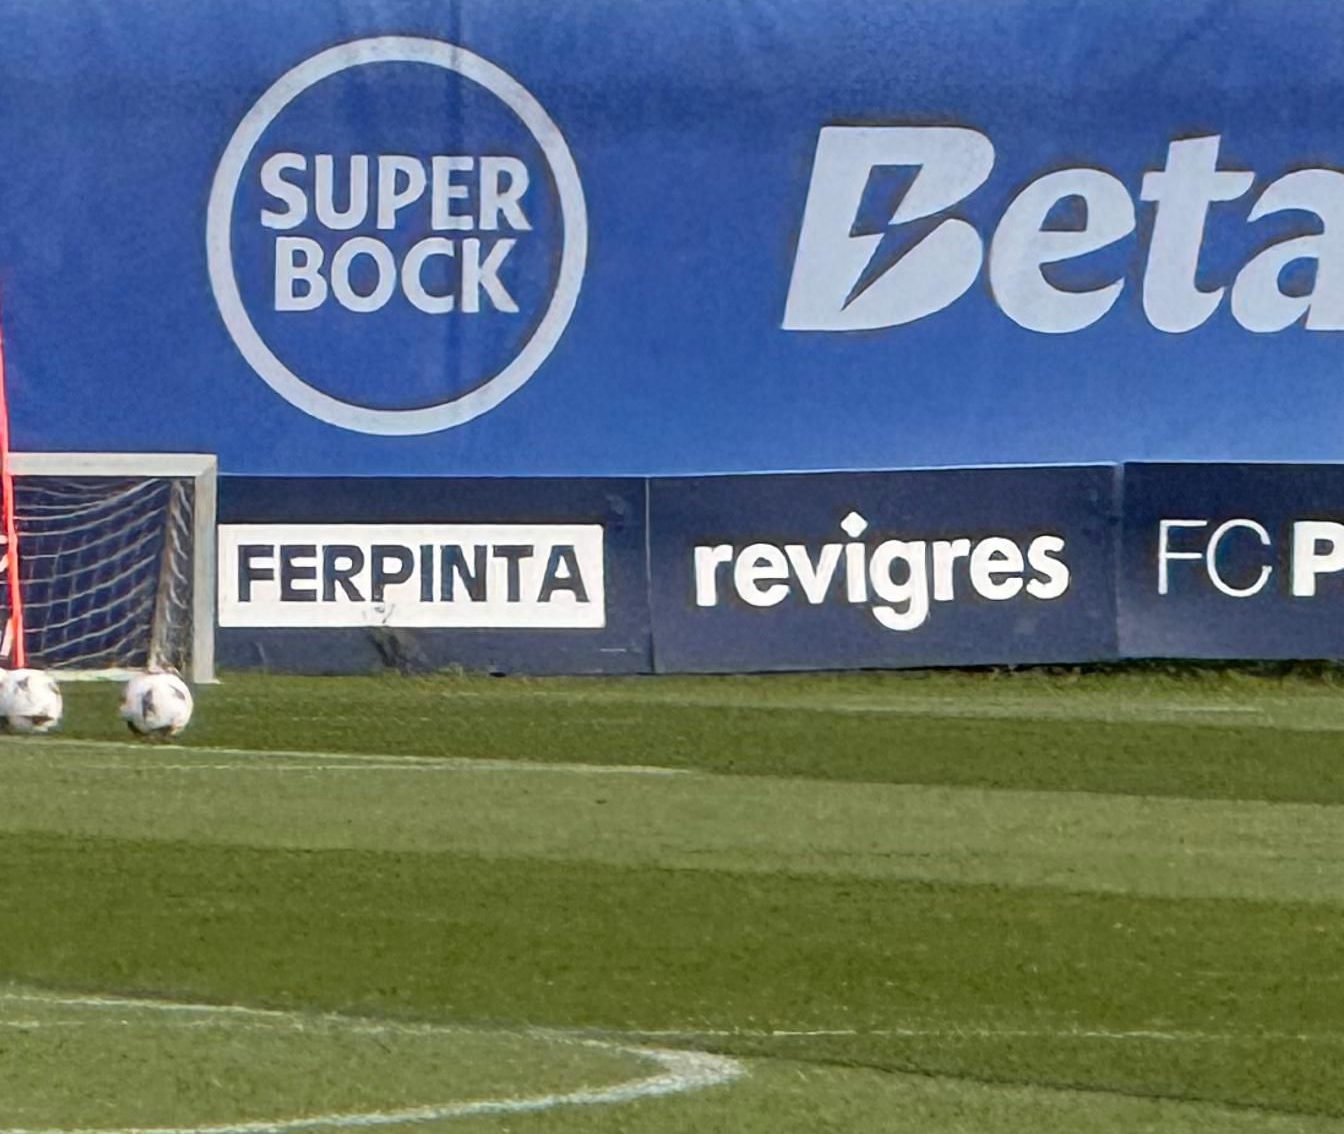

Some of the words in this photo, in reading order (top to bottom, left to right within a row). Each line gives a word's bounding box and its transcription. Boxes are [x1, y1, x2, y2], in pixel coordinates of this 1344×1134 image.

[259, 151, 534, 233] SUPER
[274, 236, 520, 315] BOCK
[237, 543, 590, 604] FERPINTA
[693, 511, 1072, 631] revigres
[1157, 518, 1273, 598] FC
